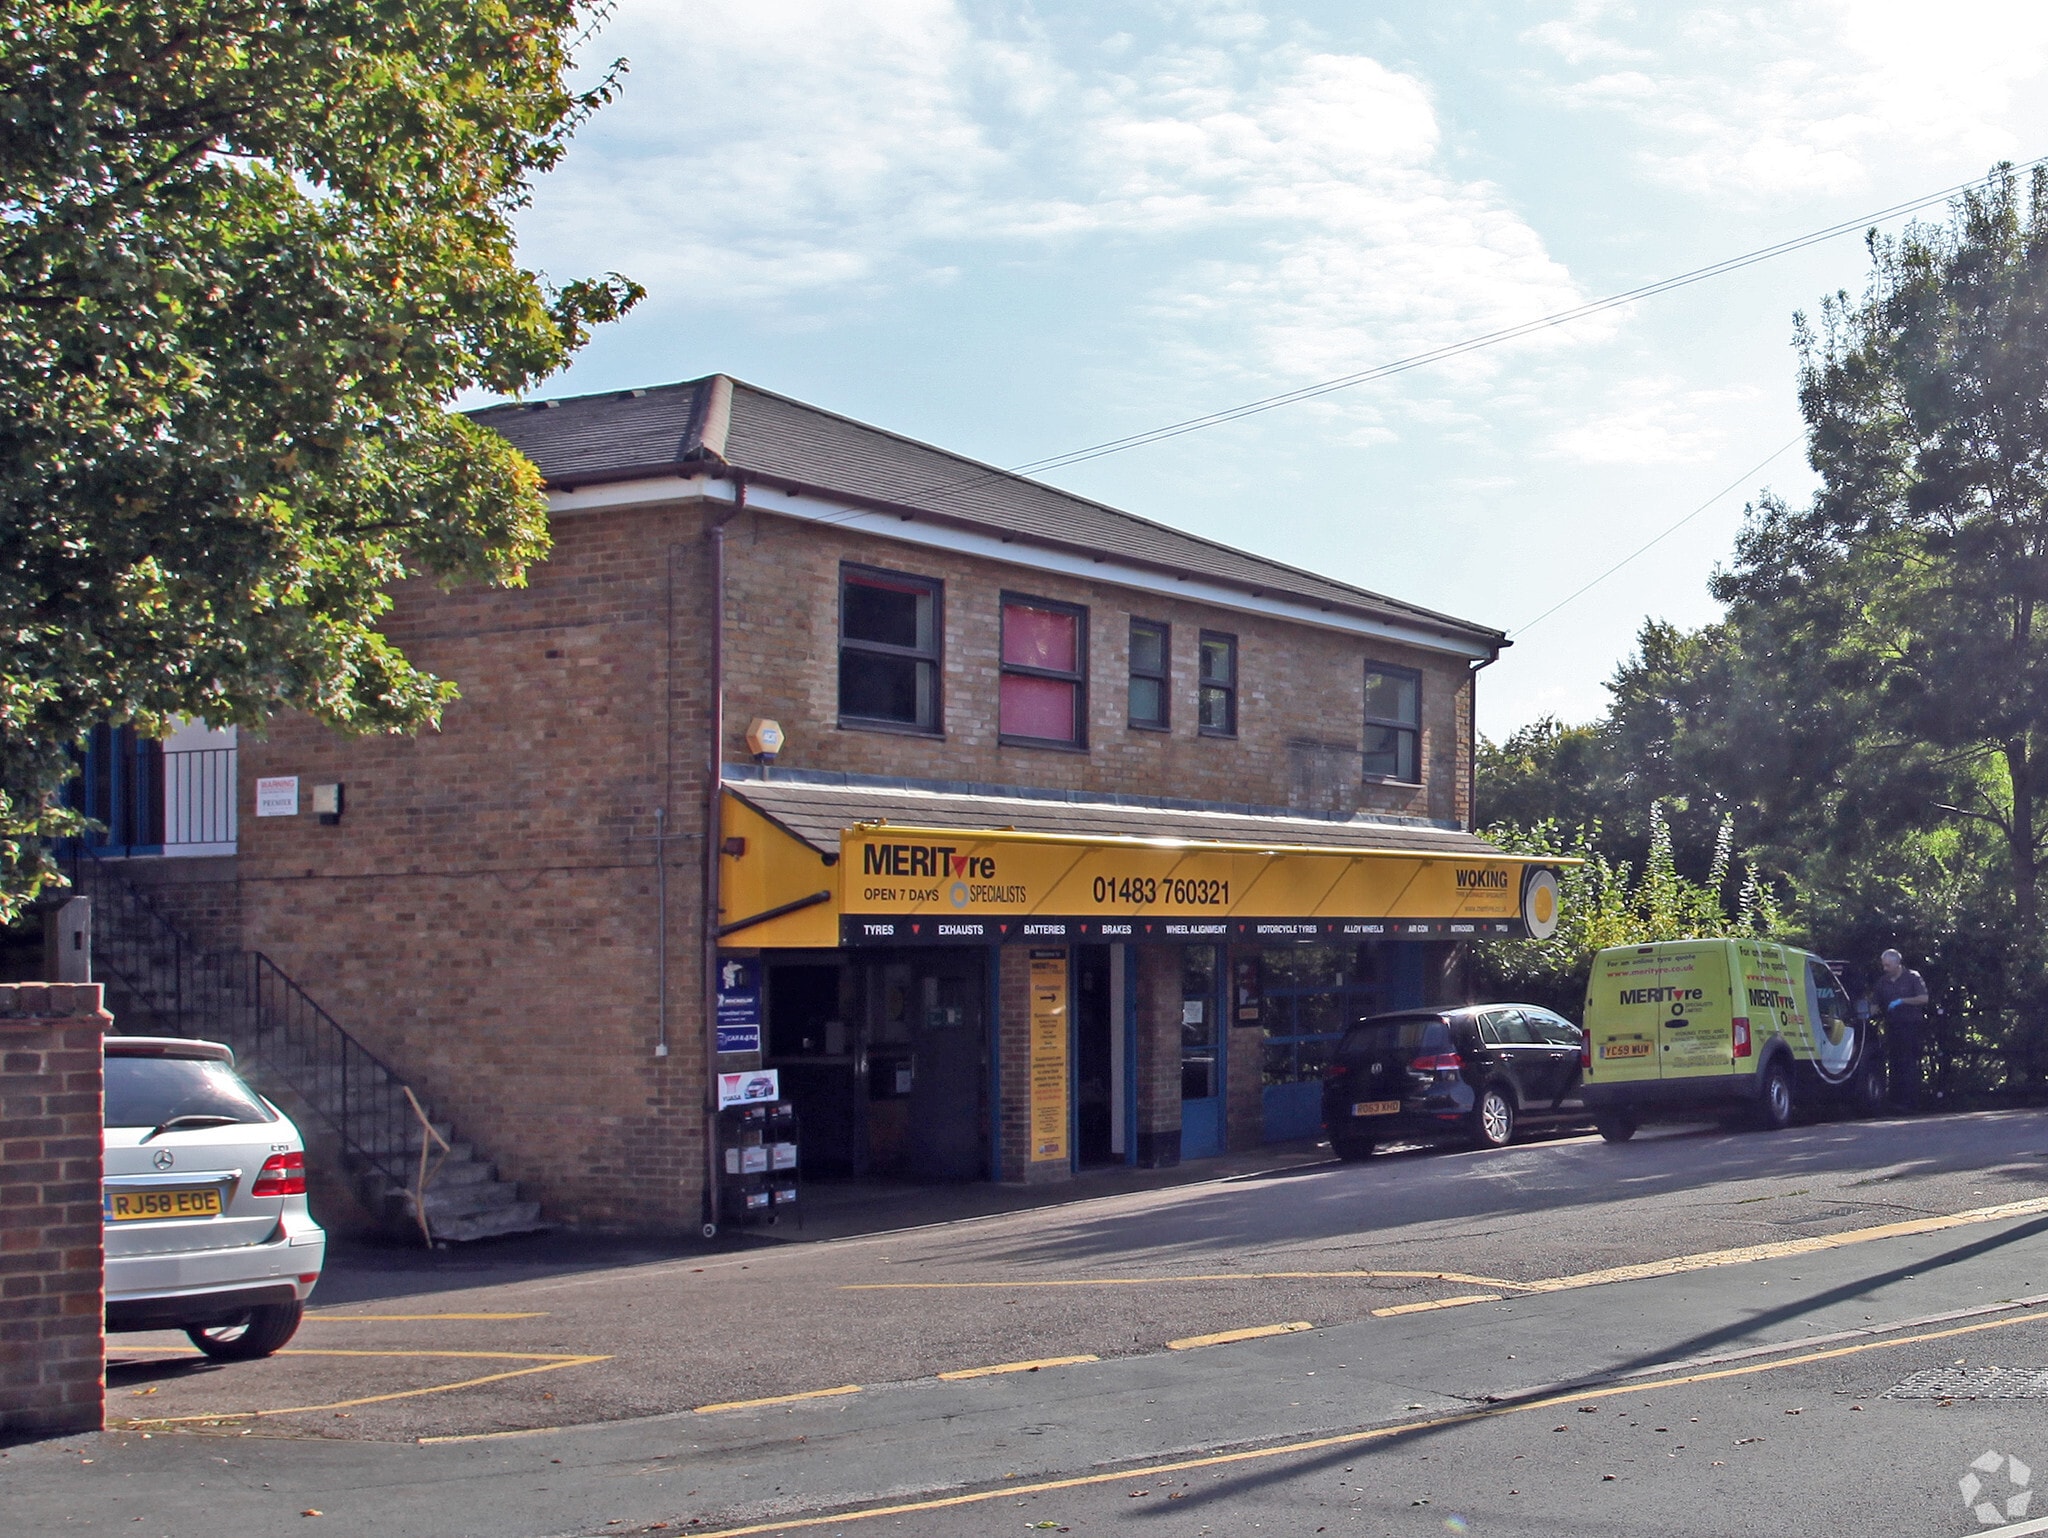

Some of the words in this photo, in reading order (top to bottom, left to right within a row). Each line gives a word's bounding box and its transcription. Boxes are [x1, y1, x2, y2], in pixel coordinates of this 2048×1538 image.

[1455, 869, 1509, 888] WOKING
[863, 887, 897, 901] OPEN
[899, 889, 906, 901] 7
[909, 889, 940, 902] DAYS
[969, 885, 1027, 904] SPECIALISTS
[1093, 876, 1157, 905] 01483
[1162, 878, 1230, 906] 760321
[863, 924, 895, 936] TYRES
[938, 924, 984, 936] EXHAUSTS
[1023, 924, 1066, 935] BATTERIES
[1101, 924, 1132, 935] BRAKES
[1165, 925, 1190, 934] WHEEL
[1190, 925, 1227, 934] ALIGNMENT
[1257, 924, 1298, 934] MOTORCYCLE
[1299, 925, 1317, 934] TYRES
[1343, 924, 1362, 934] ALLOY
[1362, 925, 1384, 934] WHEELS
[1408, 924, 1418, 933] AIR
[1418, 924, 1429, 933] CON
[1605, 1044, 1630, 1057] YC59
[116, 1194, 172, 1215] RJ58
[177, 1191, 217, 1212] EOE
